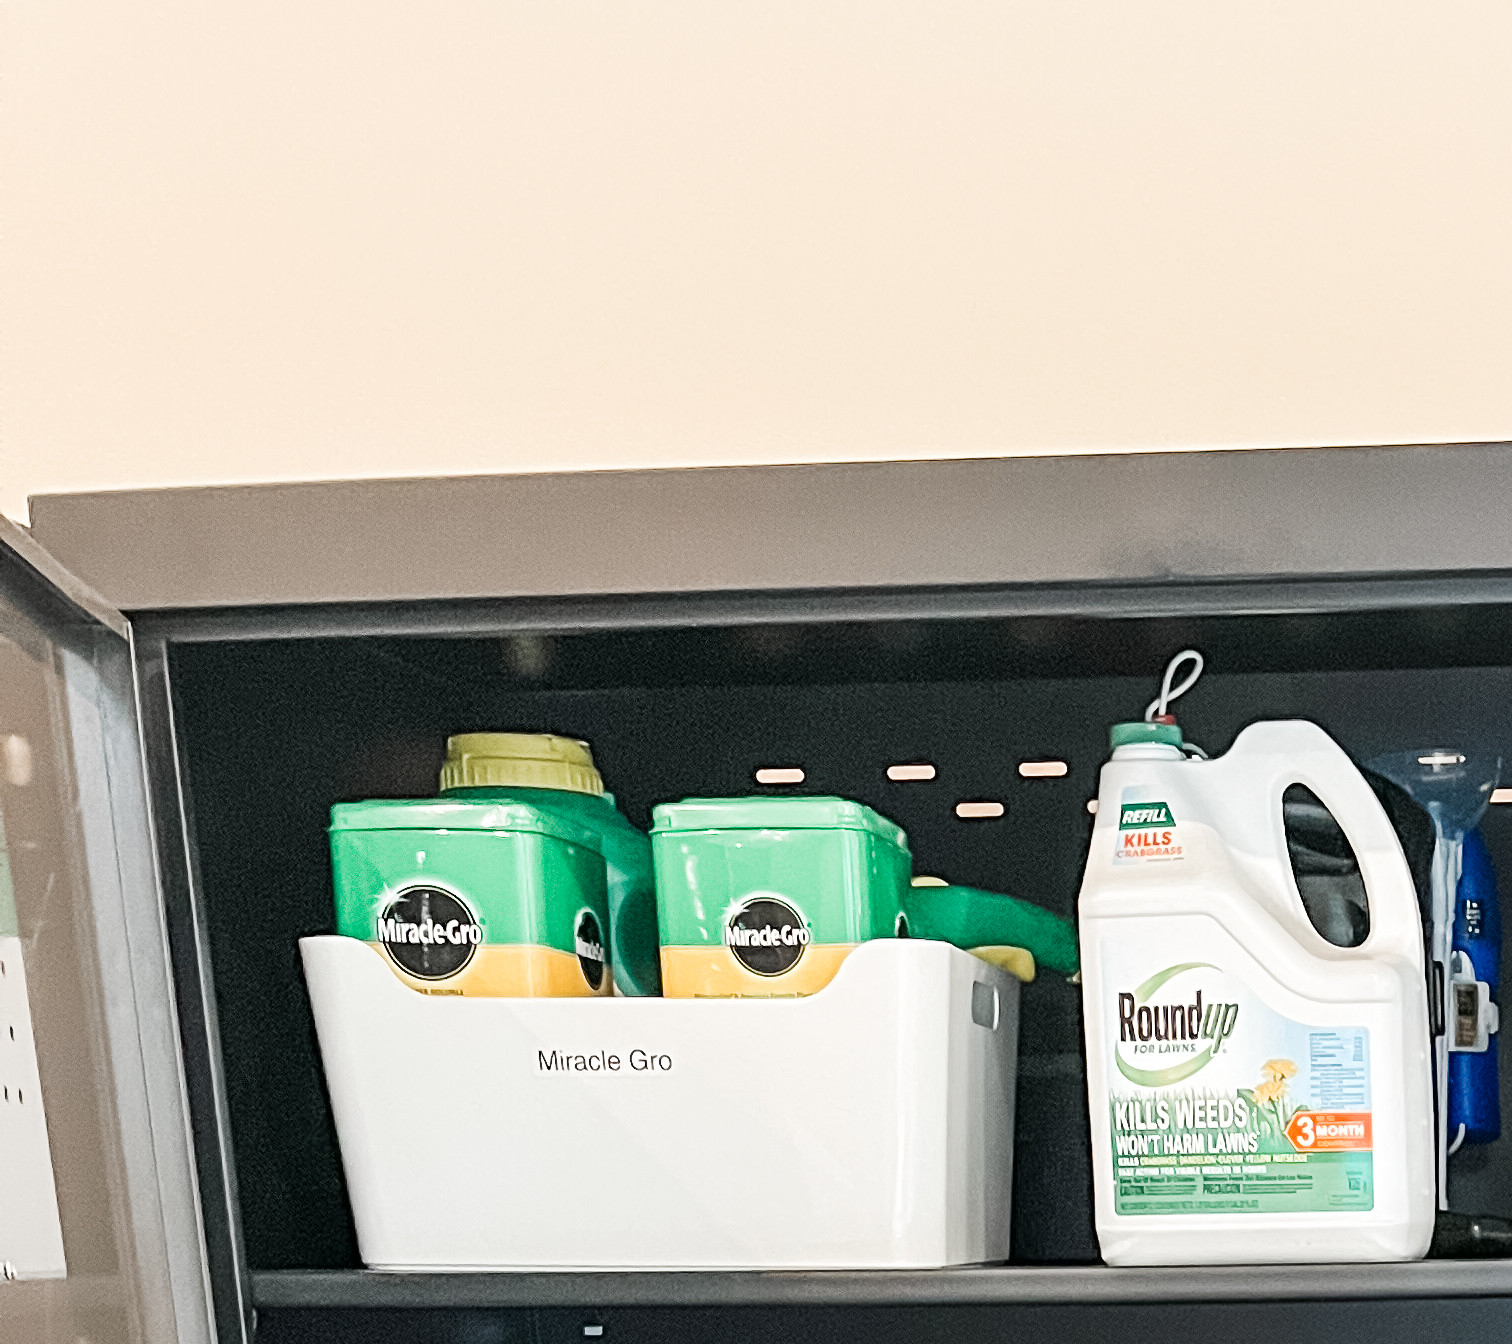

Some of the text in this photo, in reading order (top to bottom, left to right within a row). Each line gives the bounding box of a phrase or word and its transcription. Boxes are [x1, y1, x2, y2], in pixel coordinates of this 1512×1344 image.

[1122, 808, 1167, 824] REFILL
[1124, 832, 1172, 848] KILLS
[1119, 989, 1239, 1054] Roundup
[1134, 1043, 1197, 1054] FOR LAWNS
[538, 1049, 673, 1071] Miracle Gro
[1115, 1098, 1248, 1131] KILLS WEEDS
[1296, 1116, 1315, 1147] 3
[1315, 1124, 1365, 1137] MONTH
[1116, 1132, 1258, 1155] WON'T HARM LAWNS
